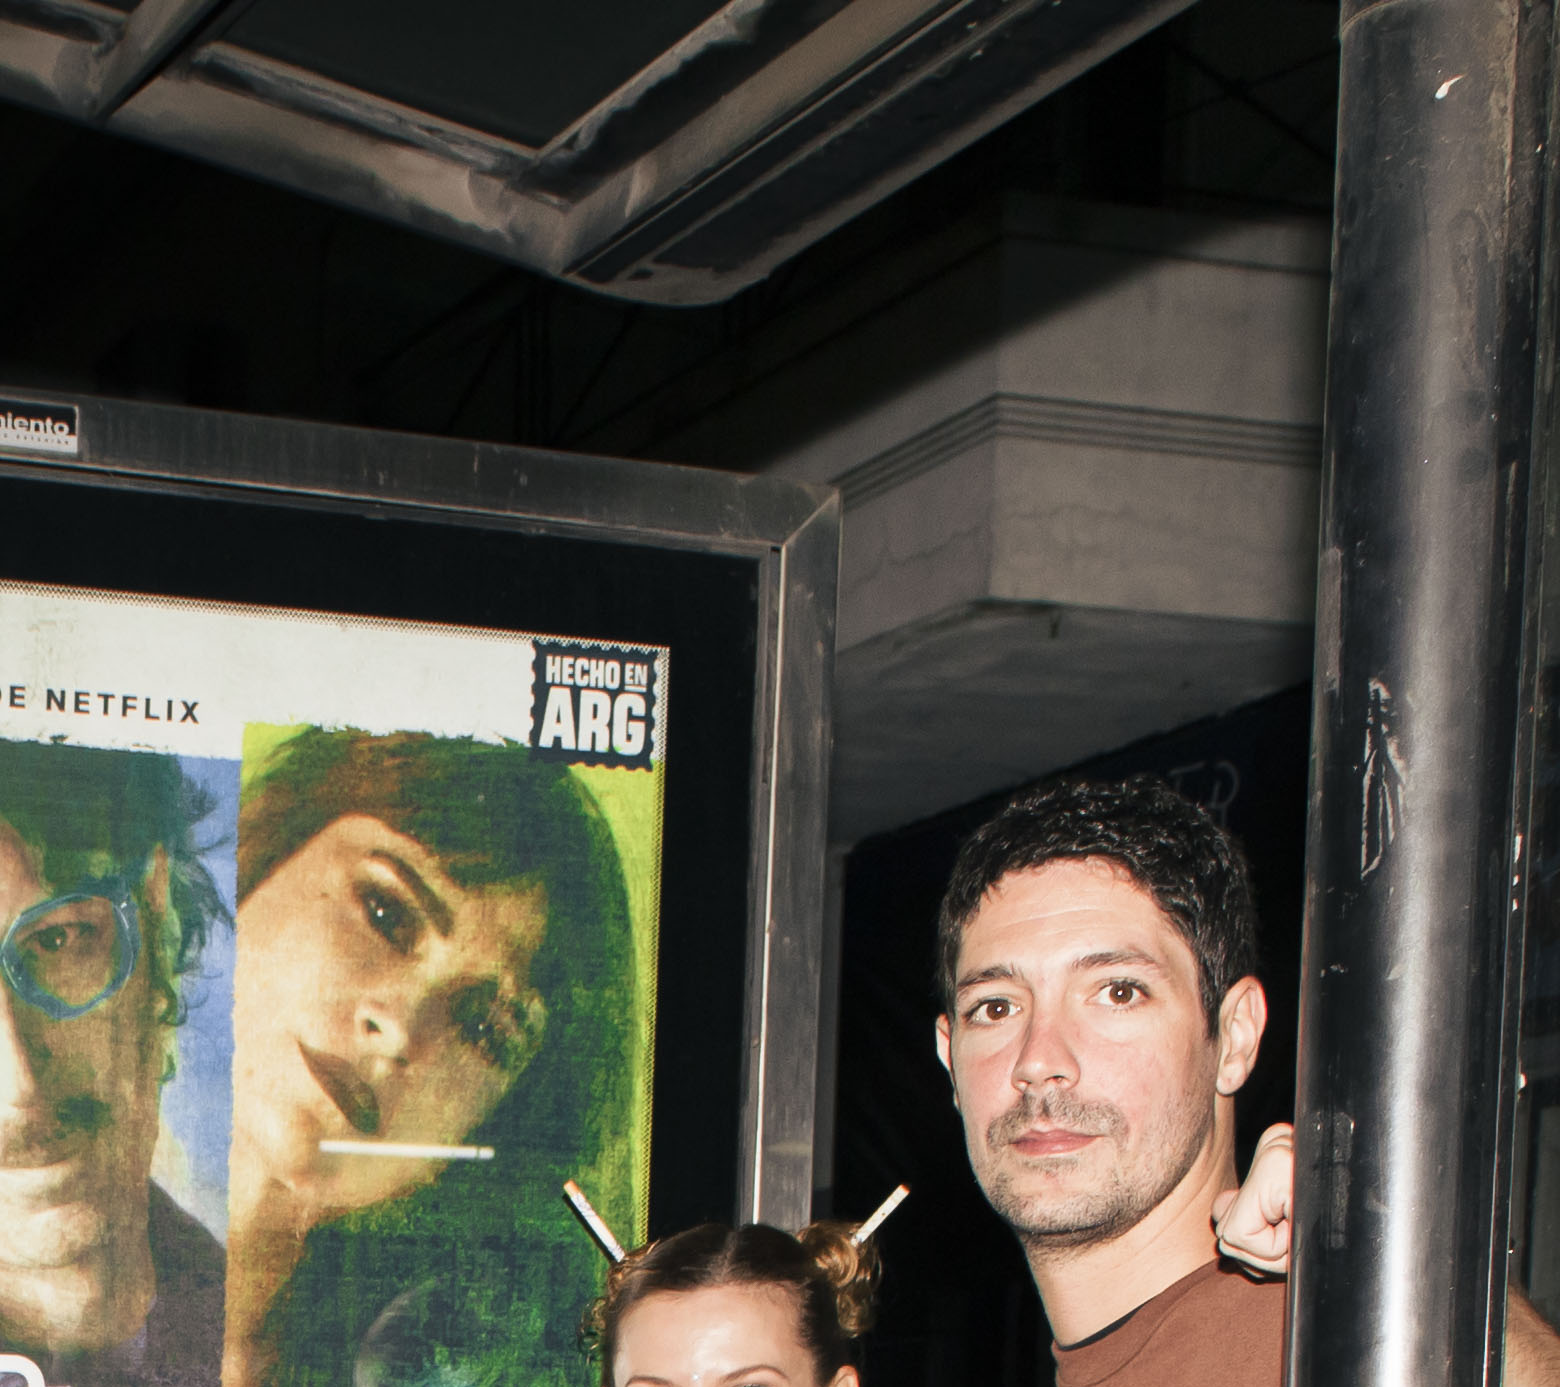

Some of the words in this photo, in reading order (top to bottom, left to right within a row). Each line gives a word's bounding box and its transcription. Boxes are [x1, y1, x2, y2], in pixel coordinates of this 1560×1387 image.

[545, 655, 621, 690] HECHO
[624, 664, 649, 688] EN
[45, 688, 201, 726] NETFLIX
[539, 691, 647, 756] ARG
